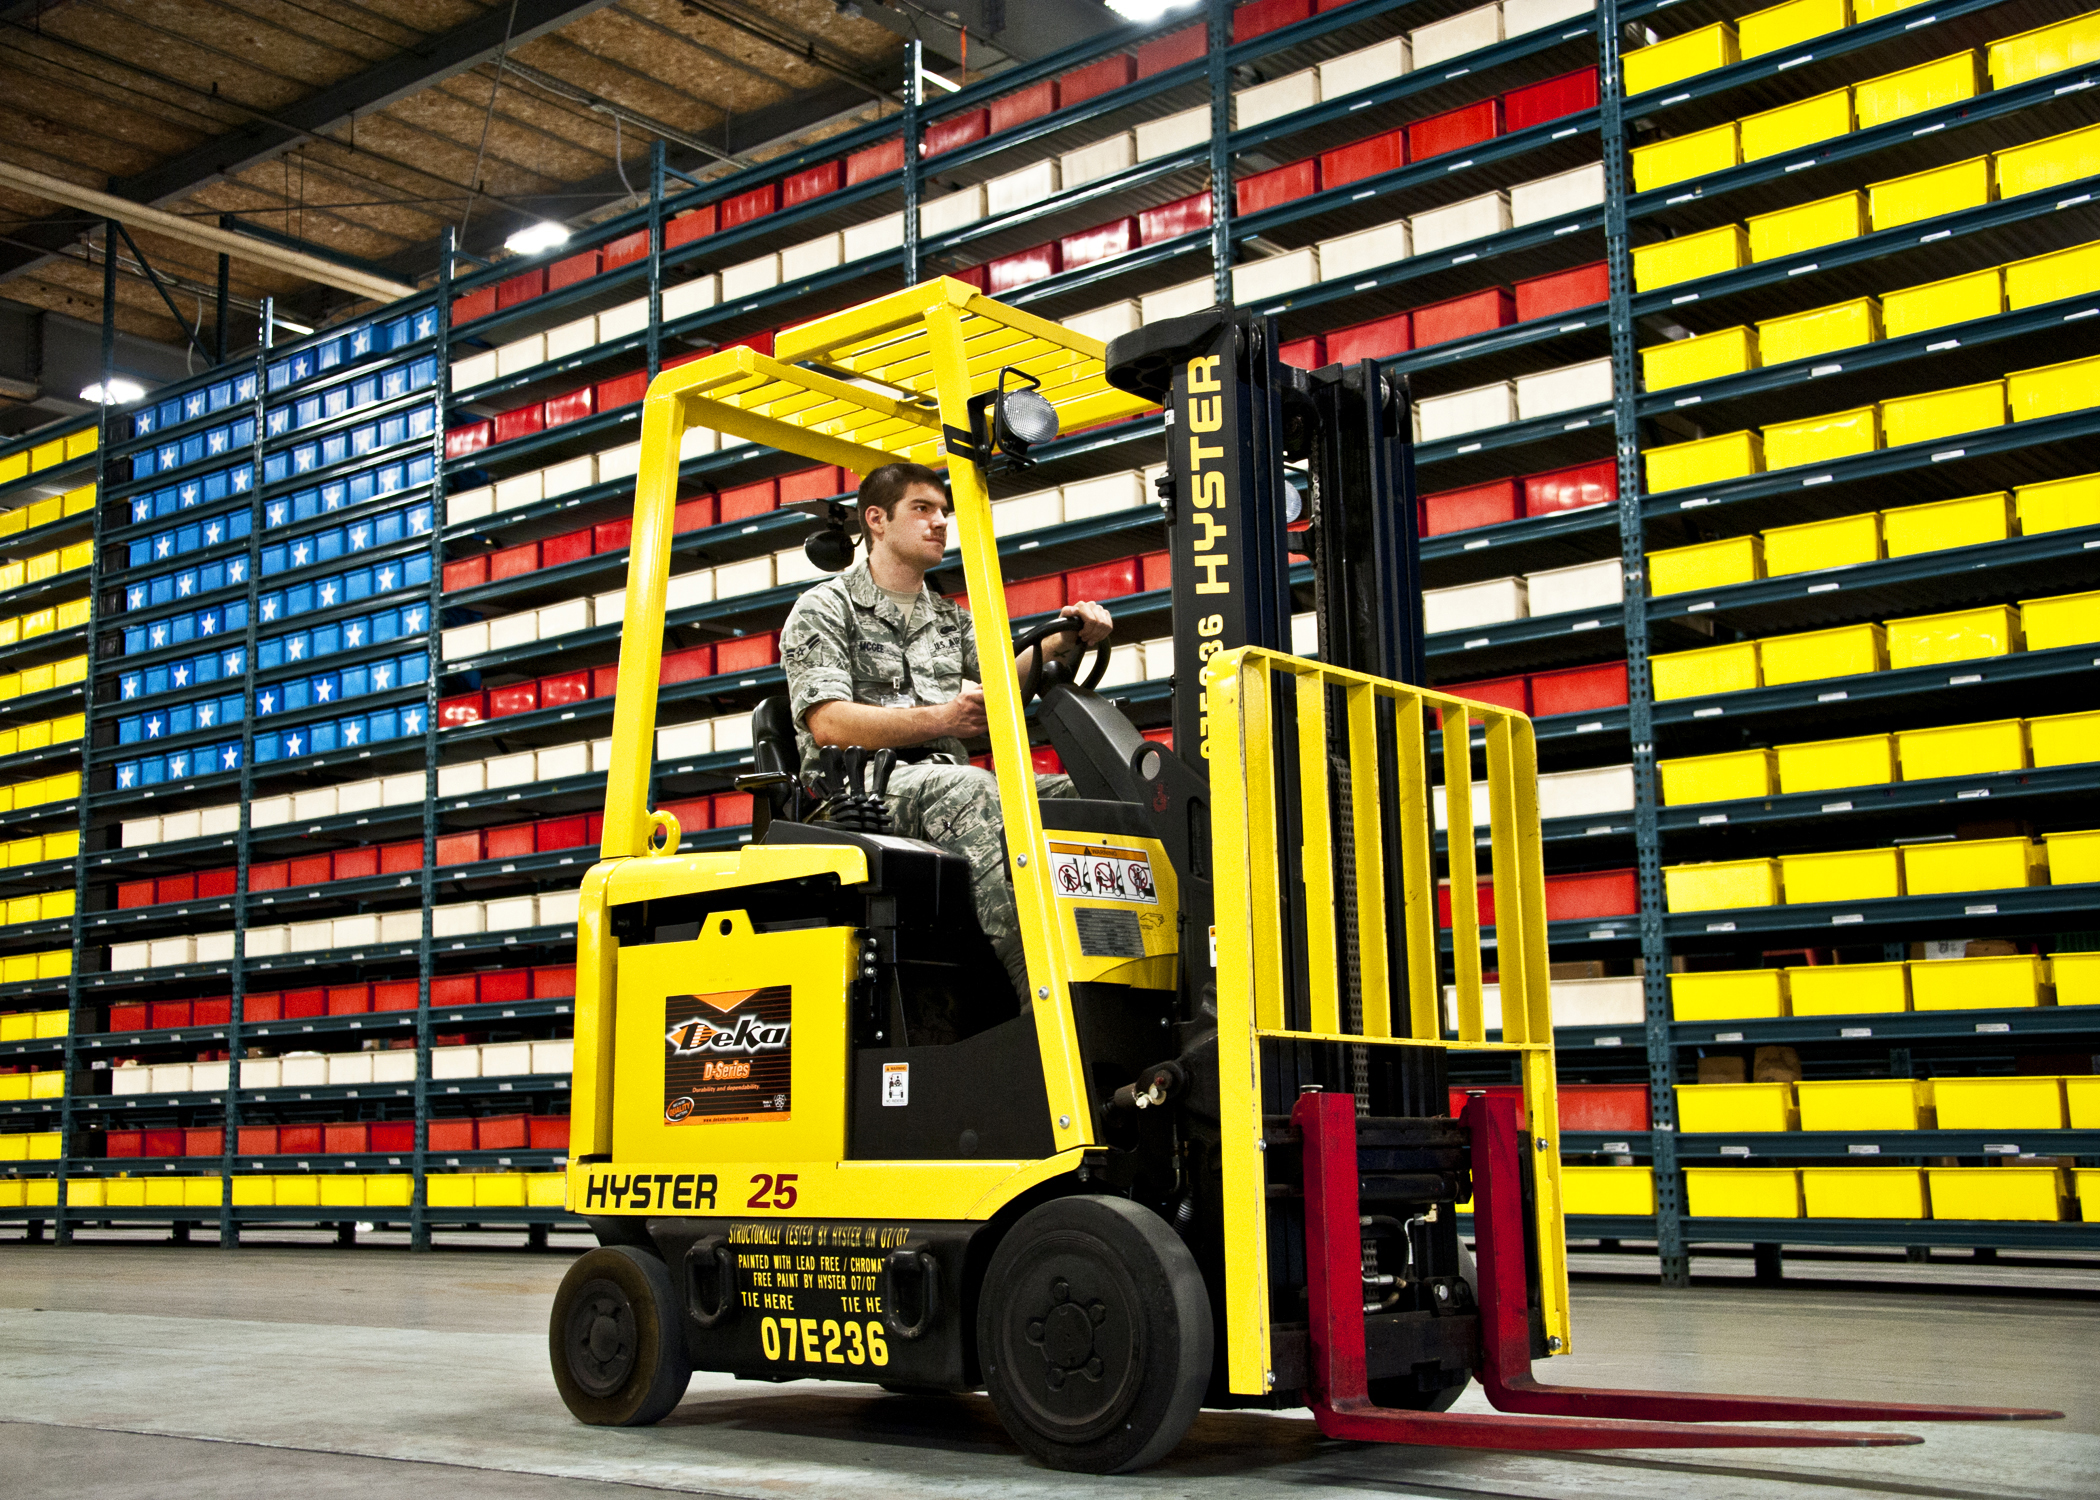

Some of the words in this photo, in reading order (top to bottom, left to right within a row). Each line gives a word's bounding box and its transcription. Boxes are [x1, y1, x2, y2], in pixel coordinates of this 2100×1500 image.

[1187, 354, 1230, 595] HYSTER
[859, 641, 884, 653] MCGEE
[679, 1019, 786, 1050] Deka
[703, 1060, 750, 1080] D-Series
[669, 1101, 690, 1117] QUALITY
[585, 1174, 718, 1210] HYSTER
[746, 1173, 799, 1210] 25
[728, 1223, 782, 1245] STRUCTURALLY
[785, 1224, 814, 1246] TESTED
[817, 1225, 829, 1246] BY
[832, 1226, 862, 1248] HYSTER
[865, 1226, 877, 1248] ON
[880, 1227, 910, 1249] 07/07
[738, 1254, 770, 1270] PAINTED
[773, 1255, 792, 1270] WITH
[795, 1255, 816, 1271] LEAD
[820, 1256, 841, 1272] FREE
[850, 1257, 886, 1273] CHROMA
[753, 1272, 773, 1288] FREE
[776, 1273, 799, 1288] PAINT
[803, 1273, 814, 1289] BY
[817, 1275, 847, 1290] HYSTER
[850, 1275, 877, 1292] 07/07
[740, 1291, 760, 1308] TIE
[764, 1293, 795, 1311] HERE
[840, 1296, 862, 1313] TIE
[865, 1296, 883, 1313] HE
[760, 1316, 889, 1367] 07E236
